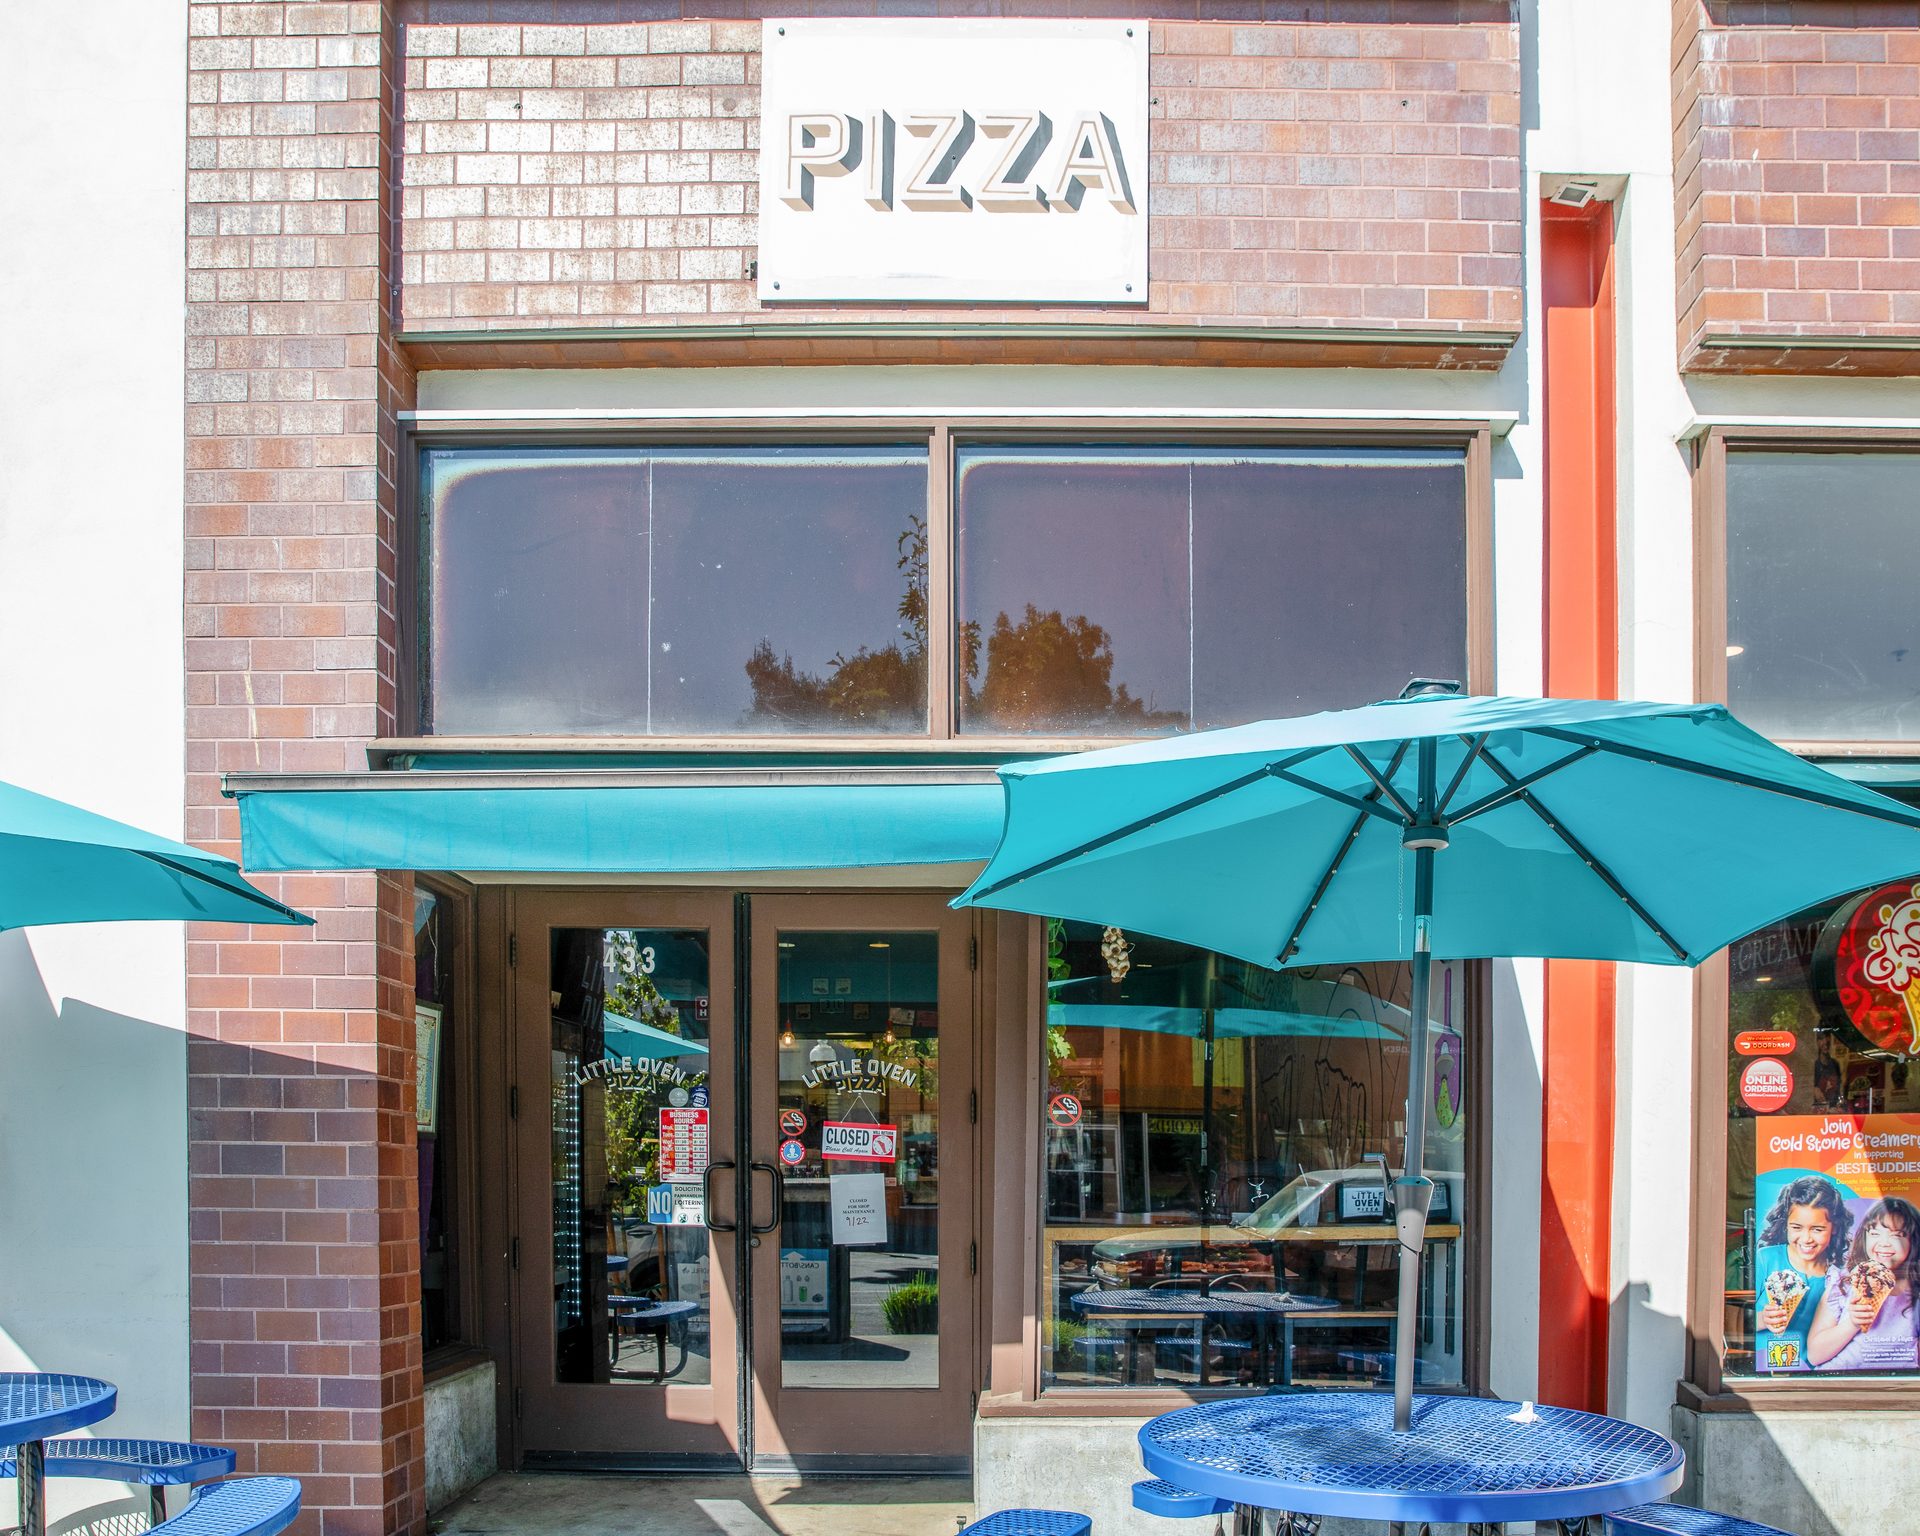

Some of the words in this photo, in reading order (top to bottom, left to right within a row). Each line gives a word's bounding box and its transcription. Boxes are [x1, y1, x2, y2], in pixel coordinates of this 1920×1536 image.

[779, 109, 1138, 215] PIZZA
[602, 946, 656, 974] 433
[573, 1056, 634, 1086] LITTLE
[637, 1056, 687, 1085] OVEN
[801, 1059, 862, 1089] LITTLE
[867, 1059, 917, 1088] OVEN
[1745, 1075, 1787, 1085] ONLINE
[836, 1076, 887, 1096] PIZZA
[1744, 1085, 1788, 1093] ORDERING
[1820, 1118, 1852, 1135] Join
[826, 1128, 870, 1146] CLOSED
[1769, 1133, 1803, 1153] Cold
[1806, 1134, 1850, 1152] Stone
[825, 1145, 841, 1153] Please
[1853, 1151, 1861, 1159] in
[1863, 1150, 1904, 1160] supporting
[650, 1191, 671, 1215] NO
[1354, 1199, 1380, 1207] OVEN
[846, 1216, 870, 1227] 9/22
